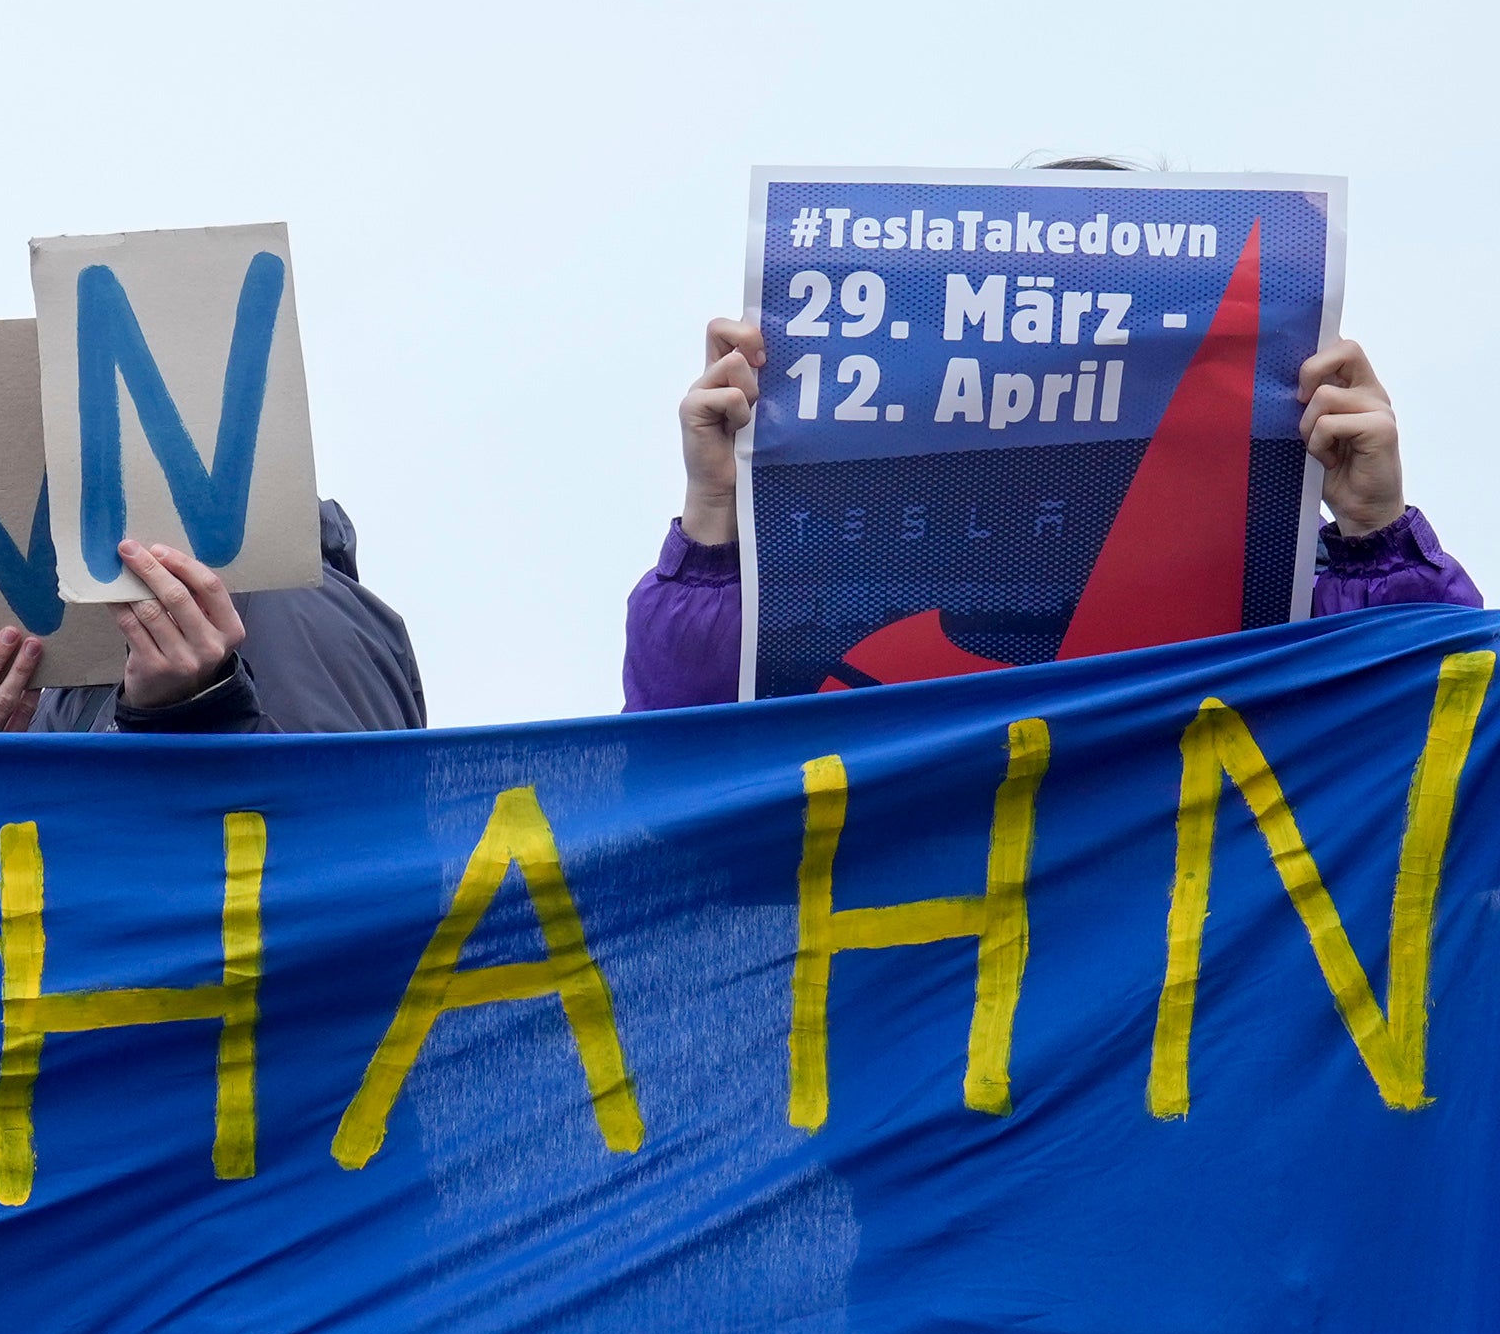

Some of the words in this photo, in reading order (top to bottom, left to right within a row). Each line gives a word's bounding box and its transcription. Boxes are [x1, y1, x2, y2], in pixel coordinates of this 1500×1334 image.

[790, 206, 1218, 258] #TeslaTakedown
[786, 269, 909, 340] 29.
[943, 273, 1132, 346] März
[1162, 314, 1187, 328] -
[76, 251, 285, 584] N
[786, 354, 904, 422] 12.
[934, 357, 1123, 430] April
